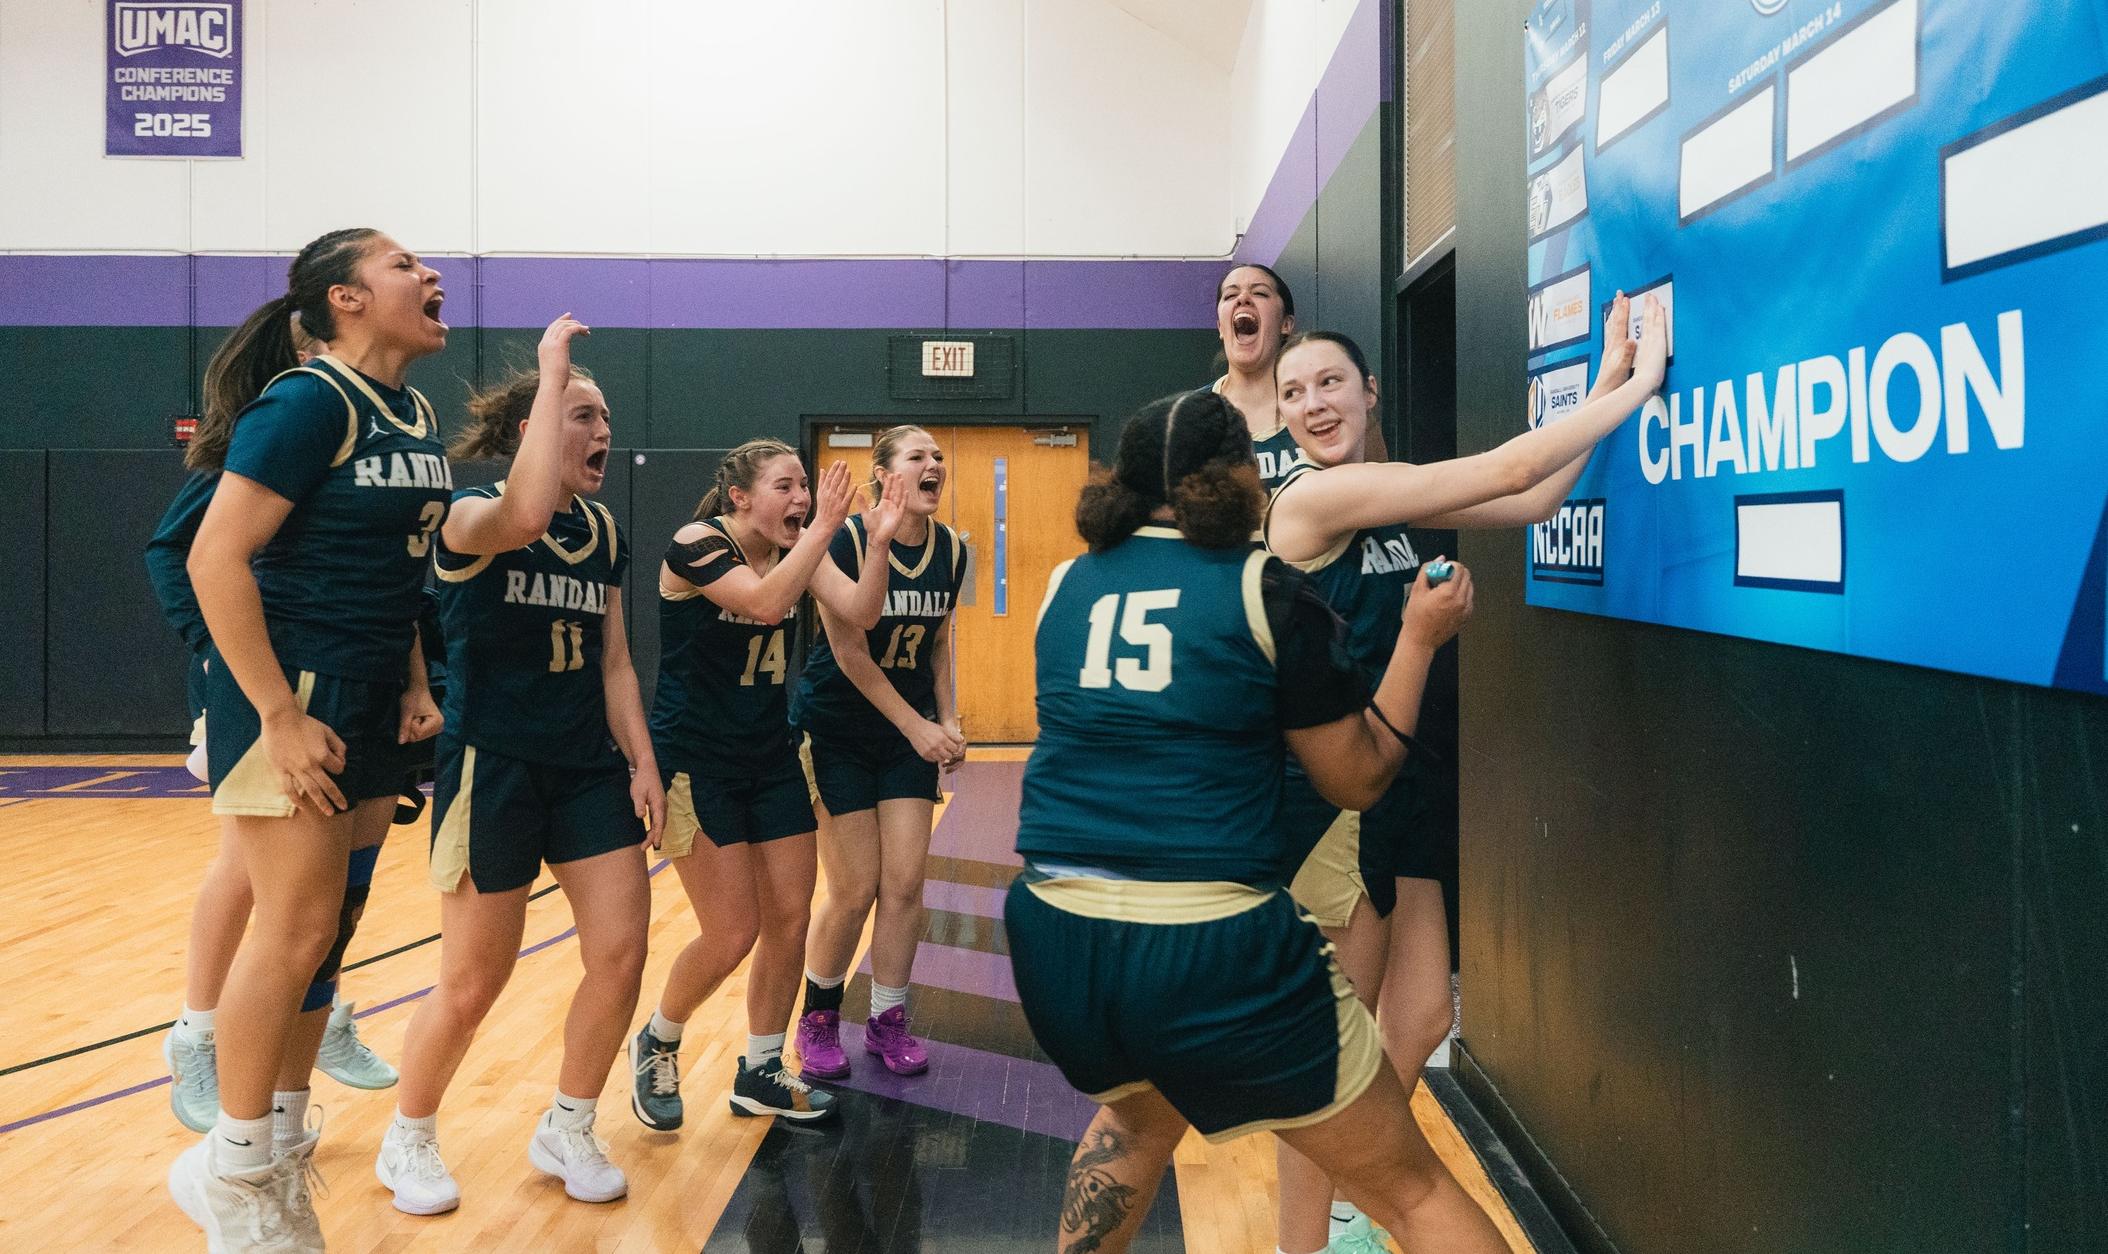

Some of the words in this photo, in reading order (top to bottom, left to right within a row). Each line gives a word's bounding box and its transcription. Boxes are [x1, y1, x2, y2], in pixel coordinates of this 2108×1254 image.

[122, 10, 224, 50] UMAC
[1603, 34, 1624, 64] FRIDAY
[1624, 8, 1650, 43] MARCH
[1728, 44, 1780, 94] SATURDAY
[1782, 14, 1824, 56] MARCH
[1825, 1, 1841, 26] 14
[115, 67, 233, 84] CONFERENCE
[121, 85, 226, 102] CHAMPIONS
[134, 112, 211, 137] 2025
[1553, 301, 1583, 321] FLAMES
[932, 346, 966, 371] EXIT
[1551, 391, 1577, 409] SAINTS
[1638, 308, 2025, 485] CHAMPION
[406, 501, 446, 558] 3
[504, 569, 608, 616] RANDAL
[549, 619, 585, 672] 11
[739, 628, 786, 686] 14
[879, 624, 927, 670] 13
[1079, 588, 1182, 693] 15
